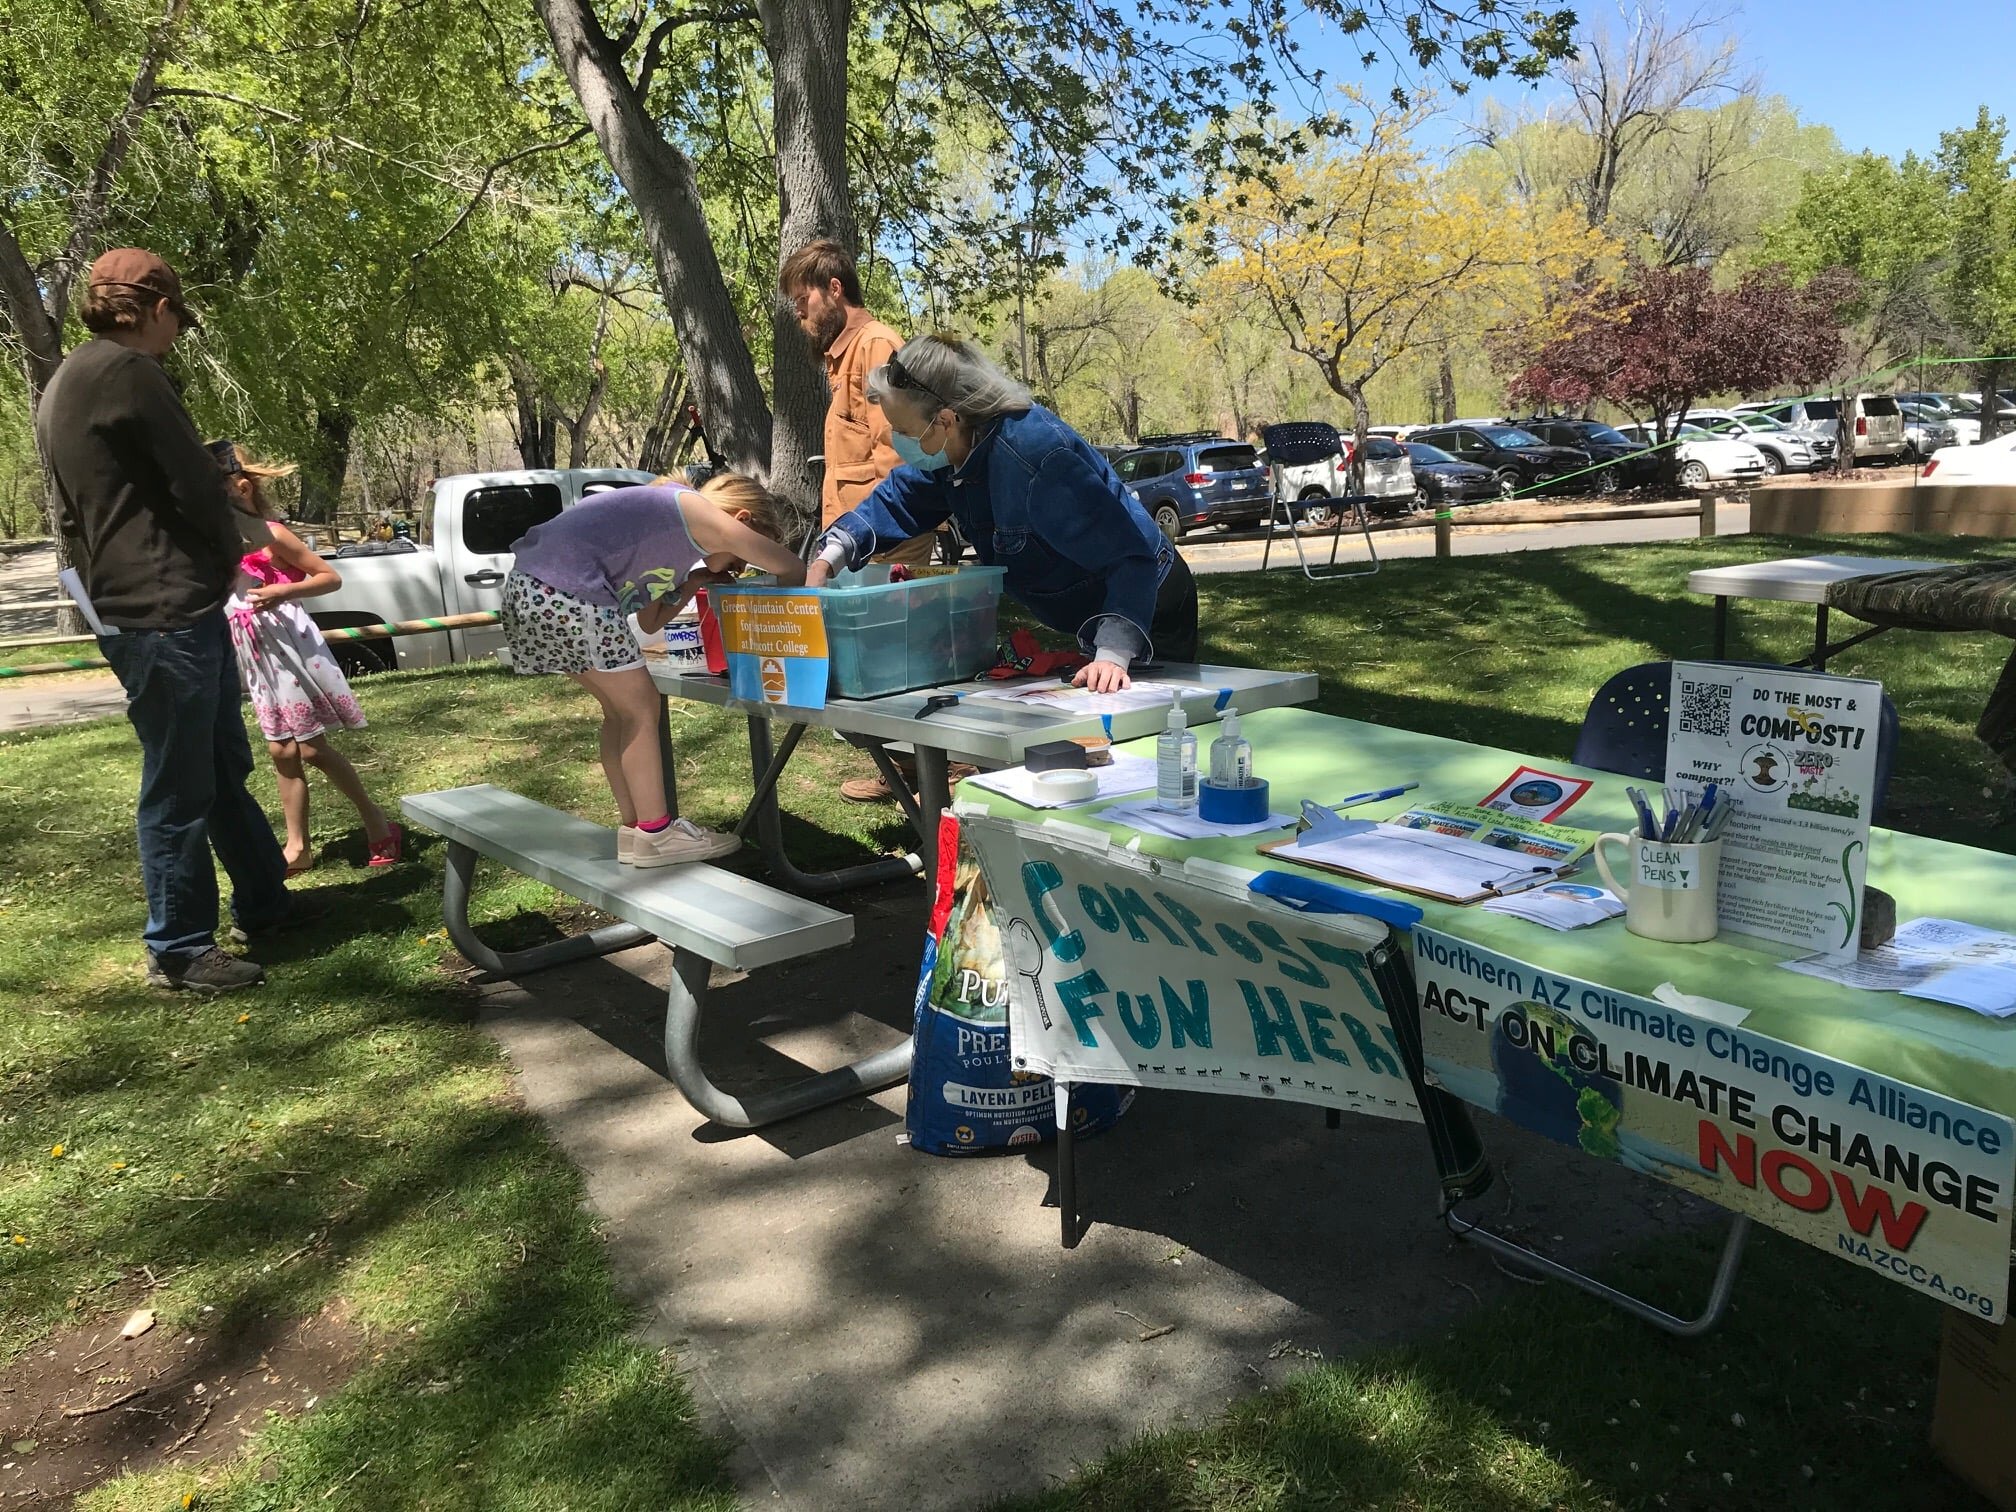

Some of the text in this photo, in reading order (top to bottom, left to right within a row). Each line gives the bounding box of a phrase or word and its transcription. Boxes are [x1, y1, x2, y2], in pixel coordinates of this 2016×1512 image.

[721, 600, 747, 613] Green
[786, 601, 818, 615] Center
[752, 621, 802, 637] stainability
[667, 630, 699, 645] COMPOST
[741, 640, 748, 650] at
[775, 640, 809, 656] College
[1752, 689, 1857, 711] DO THE MOST &
[1740, 714, 1865, 750] COMPOST!
[1693, 760, 1722, 771] WHY
[1794, 749, 1833, 768] ZERO
[1800, 767, 1825, 775] WASTE
[1676, 772, 1736, 787] compost?!
[1730, 820, 1761, 832] footprint
[1747, 811, 1762, 820] food
[1769, 816, 1792, 825] wasted
[1810, 821, 1830, 831] billion
[1831, 825, 1855, 836] tons/yr
[1435, 826, 1465, 838] NOW
[1736, 832, 1749, 840] that
[1750, 834, 1760, 842] the
[1524, 845, 1559, 857] NOW
[1641, 846, 1681, 865] CLEAN
[1785, 848, 1792, 856] to
[1793, 851, 1804, 860] get
[1805, 851, 1821, 862] from
[1821, 855, 1839, 865] farm
[1749, 861, 1762, 869] your
[1810, 871, 1825, 880] Your
[1825, 875, 1841, 884] food
[1792, 876, 1808, 884] fuels
[1809, 879, 1816, 887] to
[1817, 881, 1826, 889] be
[1727, 894, 1751, 903] nutrient
[1764, 900, 1791, 911] fertilizer
[1791, 906, 1805, 915] that
[1806, 909, 1823, 920] helps
[1806, 917, 1815, 925] by
[1021, 860, 1388, 1012] COMPOST
[1781, 926, 1791, 934] for
[1812, 926, 1826, 935] This
[1054, 968, 1403, 1079] FUN HER
[1417, 932, 2001, 1155] Northern AZ Climate Change Alliance
[961, 1088, 1017, 1106] LAYENA
[1423, 980, 2000, 1224] ACT ON CLIMATE CHANGE
[965, 1110, 993, 1119] OPTIMUM
[993, 1109, 1026, 1119] NUTRITION
[1003, 1115, 1038, 1126] NUTRITIOUS
[1011, 1133, 1038, 1143] OYSTER
[1698, 1118, 1929, 1252] NOW
[1838, 1232, 1994, 1317] NAZCCA.org
